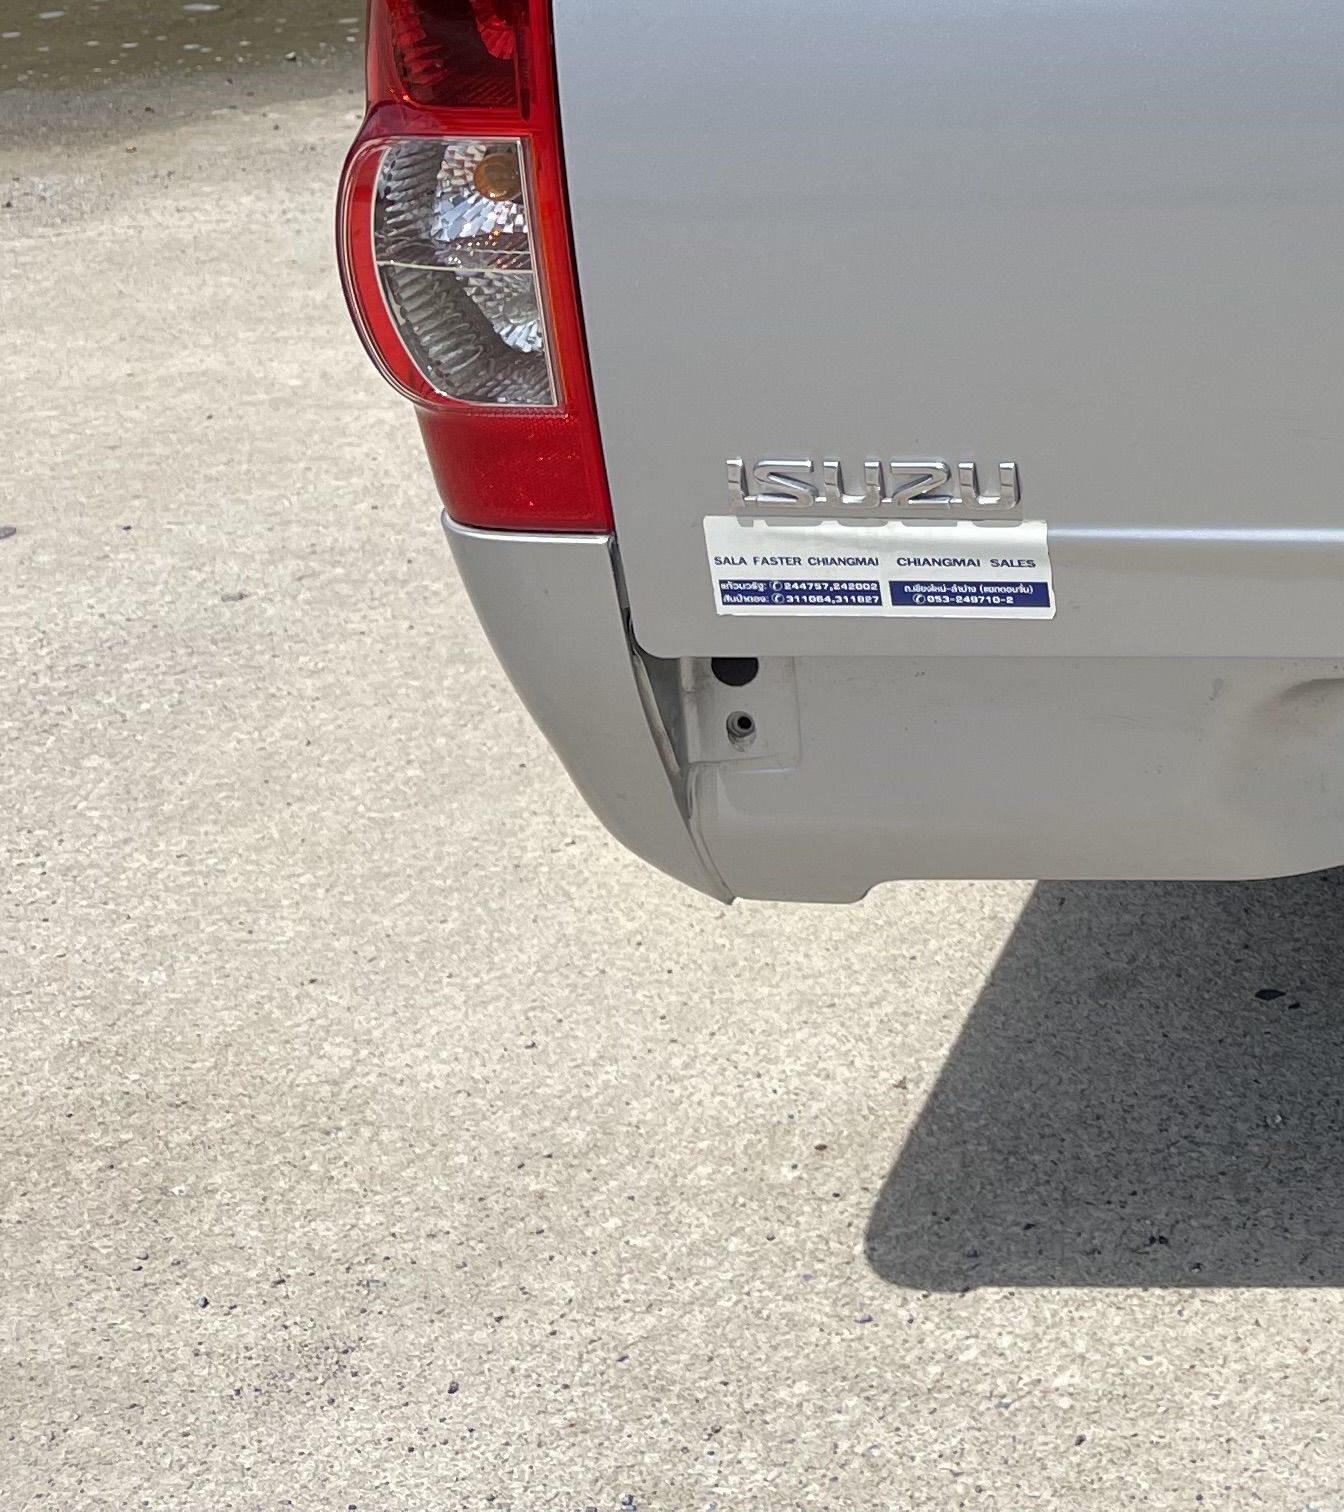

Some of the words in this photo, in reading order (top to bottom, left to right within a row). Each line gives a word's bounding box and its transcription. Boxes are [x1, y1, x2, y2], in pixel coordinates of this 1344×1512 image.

[726, 457, 1021, 510] ISUZU
[713, 555, 748, 567] SALA
[753, 555, 802, 567] FASTER
[807, 556, 880, 567] CHIANGMAI
[896, 557, 981, 568] CHIANGMAI
[990, 558, 1037, 568] SALES
